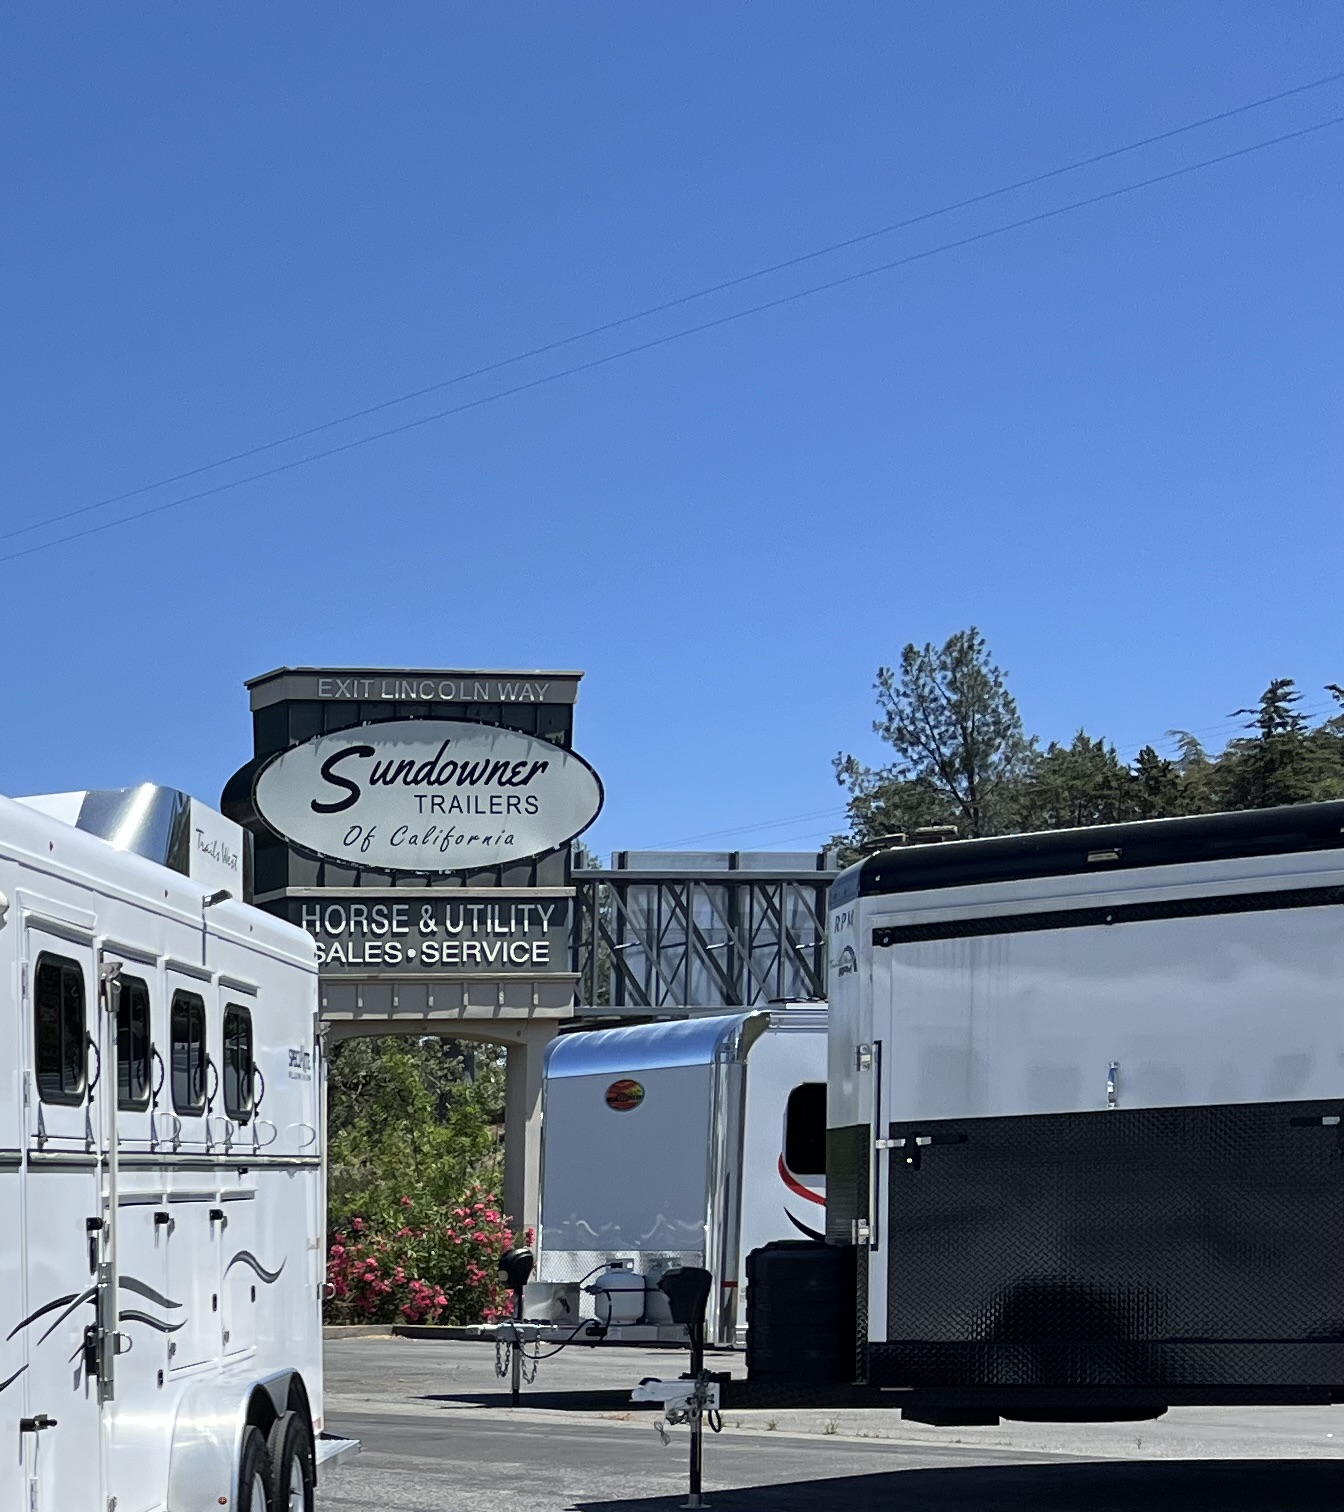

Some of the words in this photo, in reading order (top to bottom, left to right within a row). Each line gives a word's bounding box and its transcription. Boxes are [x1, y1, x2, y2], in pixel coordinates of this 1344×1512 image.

[318, 678, 374, 698] EXIT
[381, 679, 489, 700] LINCOLN
[498, 682, 550, 701] WAY
[311, 739, 549, 814] Sundowner
[414, 795, 539, 815] TRAILERS
[343, 825, 376, 852] Of
[390, 825, 515, 853] California
[301, 904, 409, 933] HORSE
[420, 904, 437, 933] &
[446, 904, 555, 932] UTILITY
[315, 942, 402, 963] SALES
[421, 941, 550, 963] SERVICE
